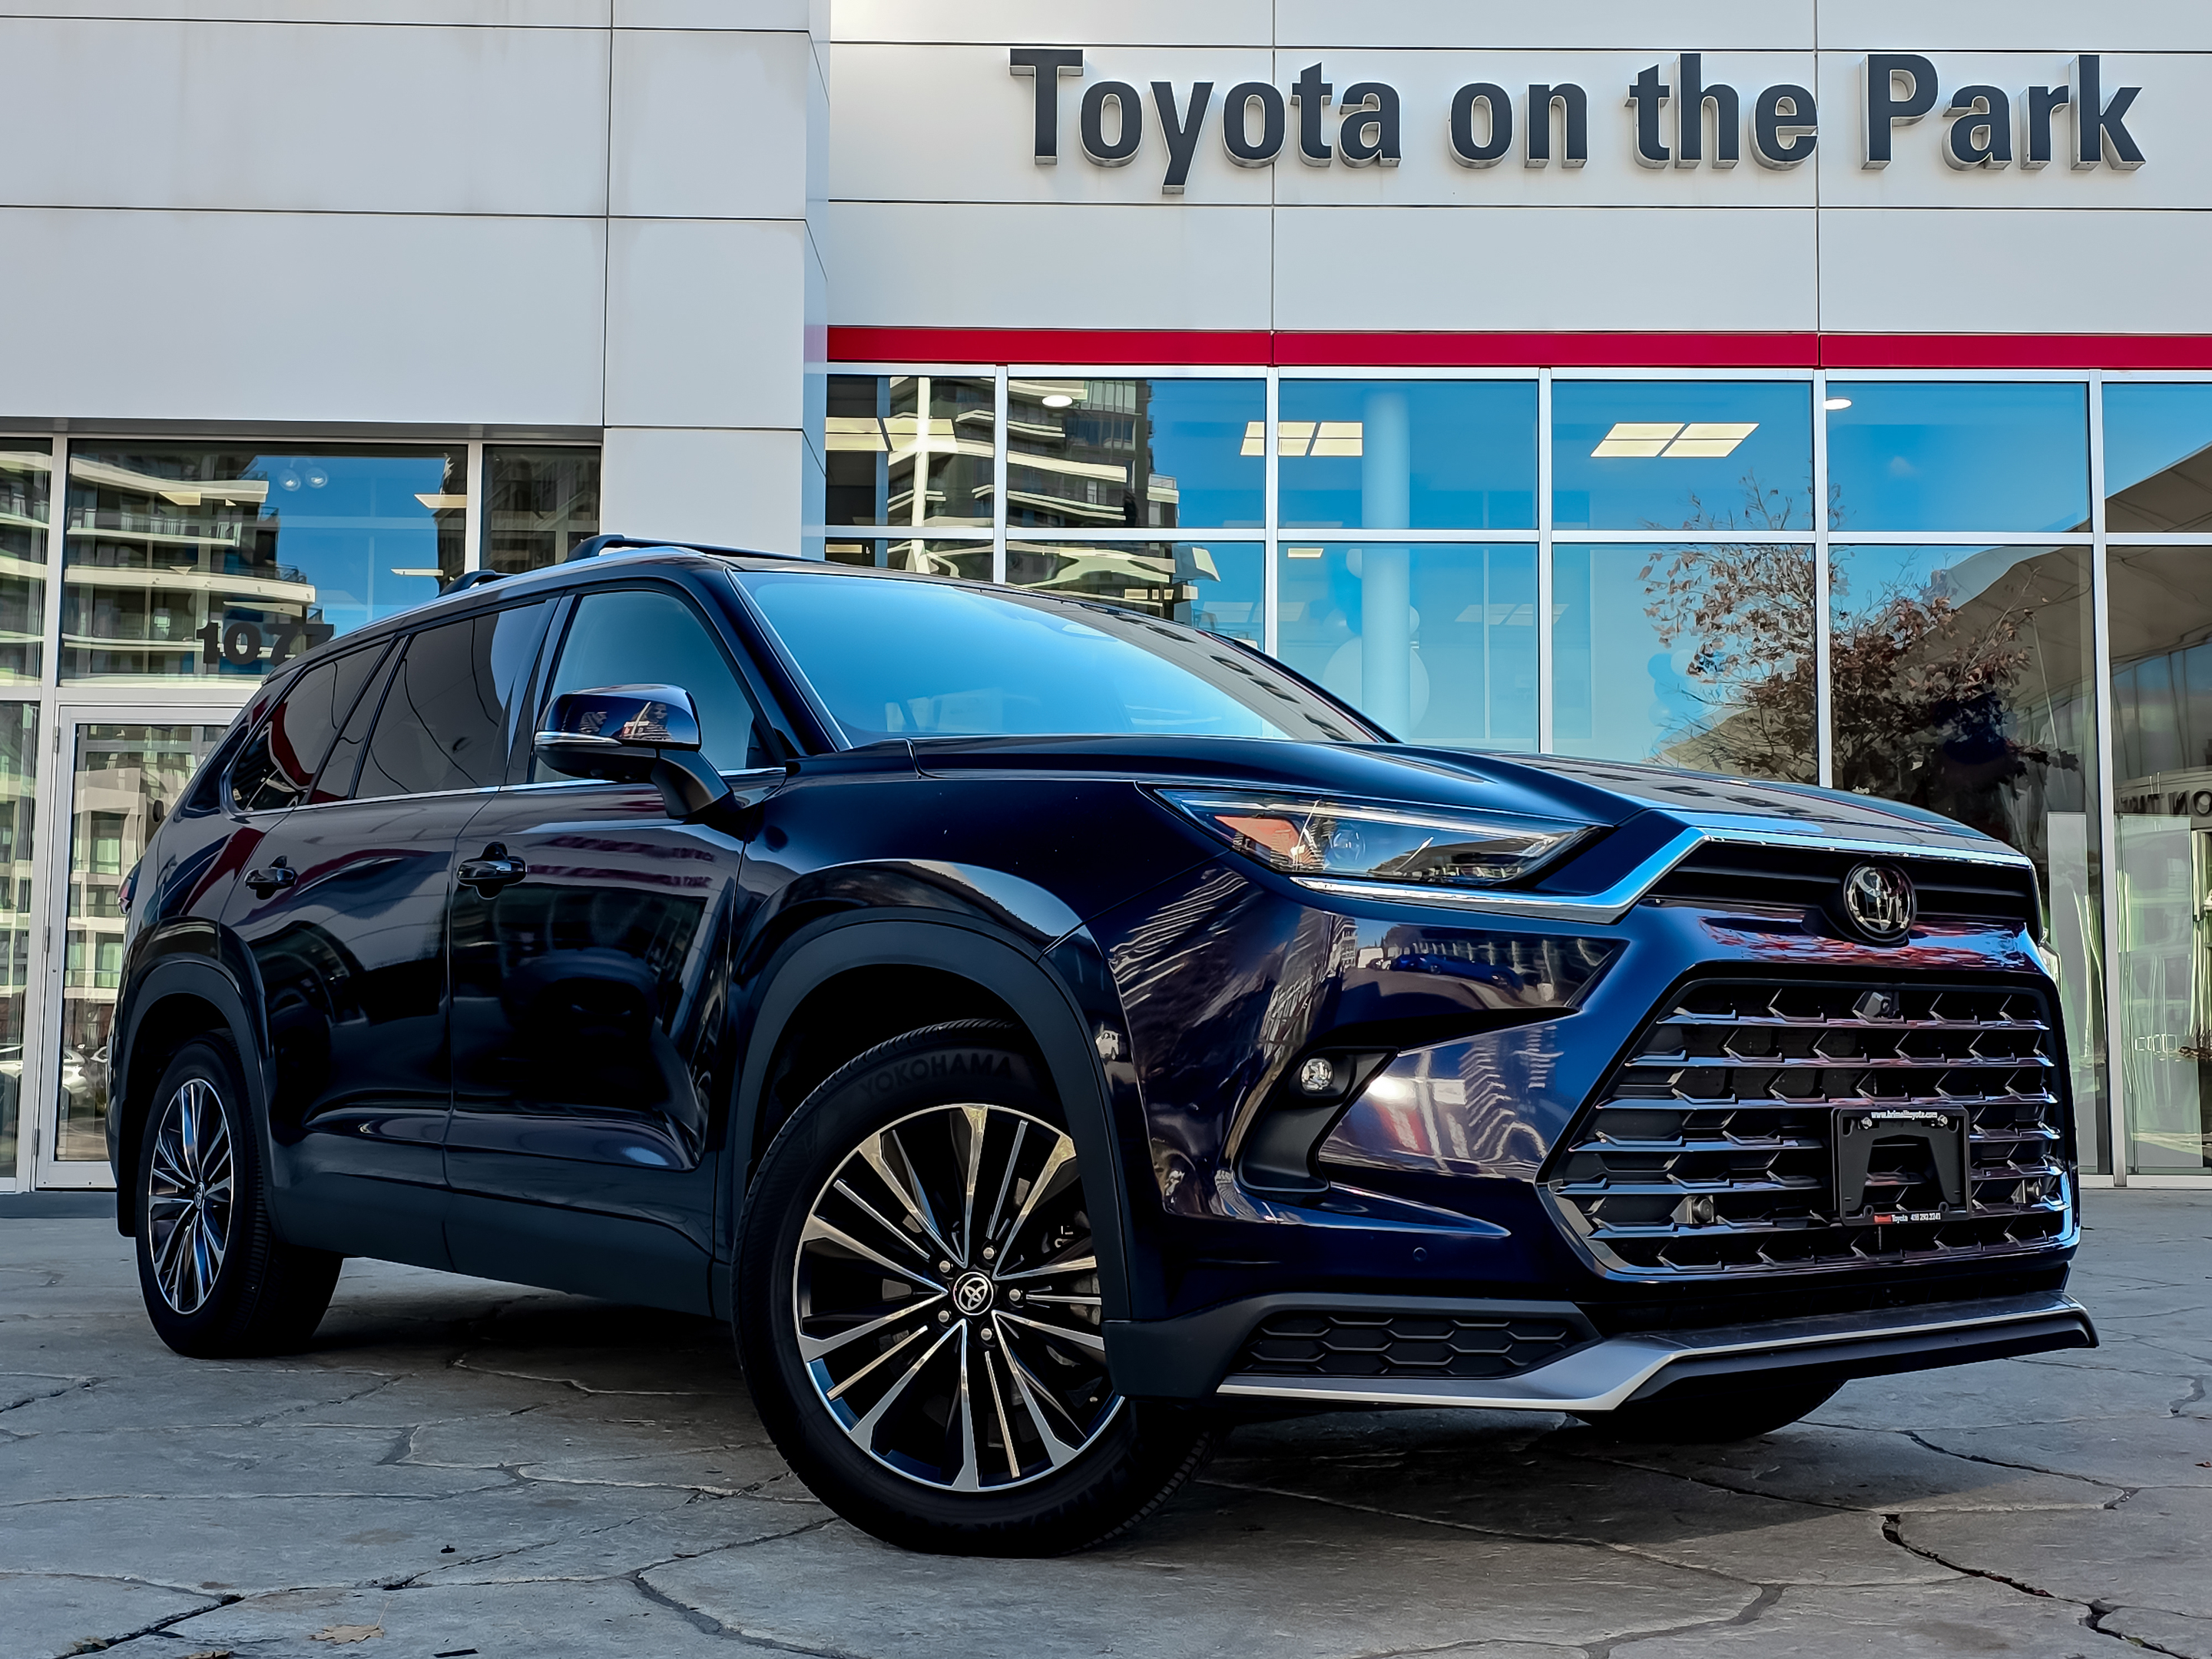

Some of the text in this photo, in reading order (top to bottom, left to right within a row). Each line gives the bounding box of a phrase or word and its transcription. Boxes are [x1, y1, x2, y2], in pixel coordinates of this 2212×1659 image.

[1009, 48, 2147, 194] Toyota on the Park
[858, 1052, 1014, 1100] YOKOHAMA
